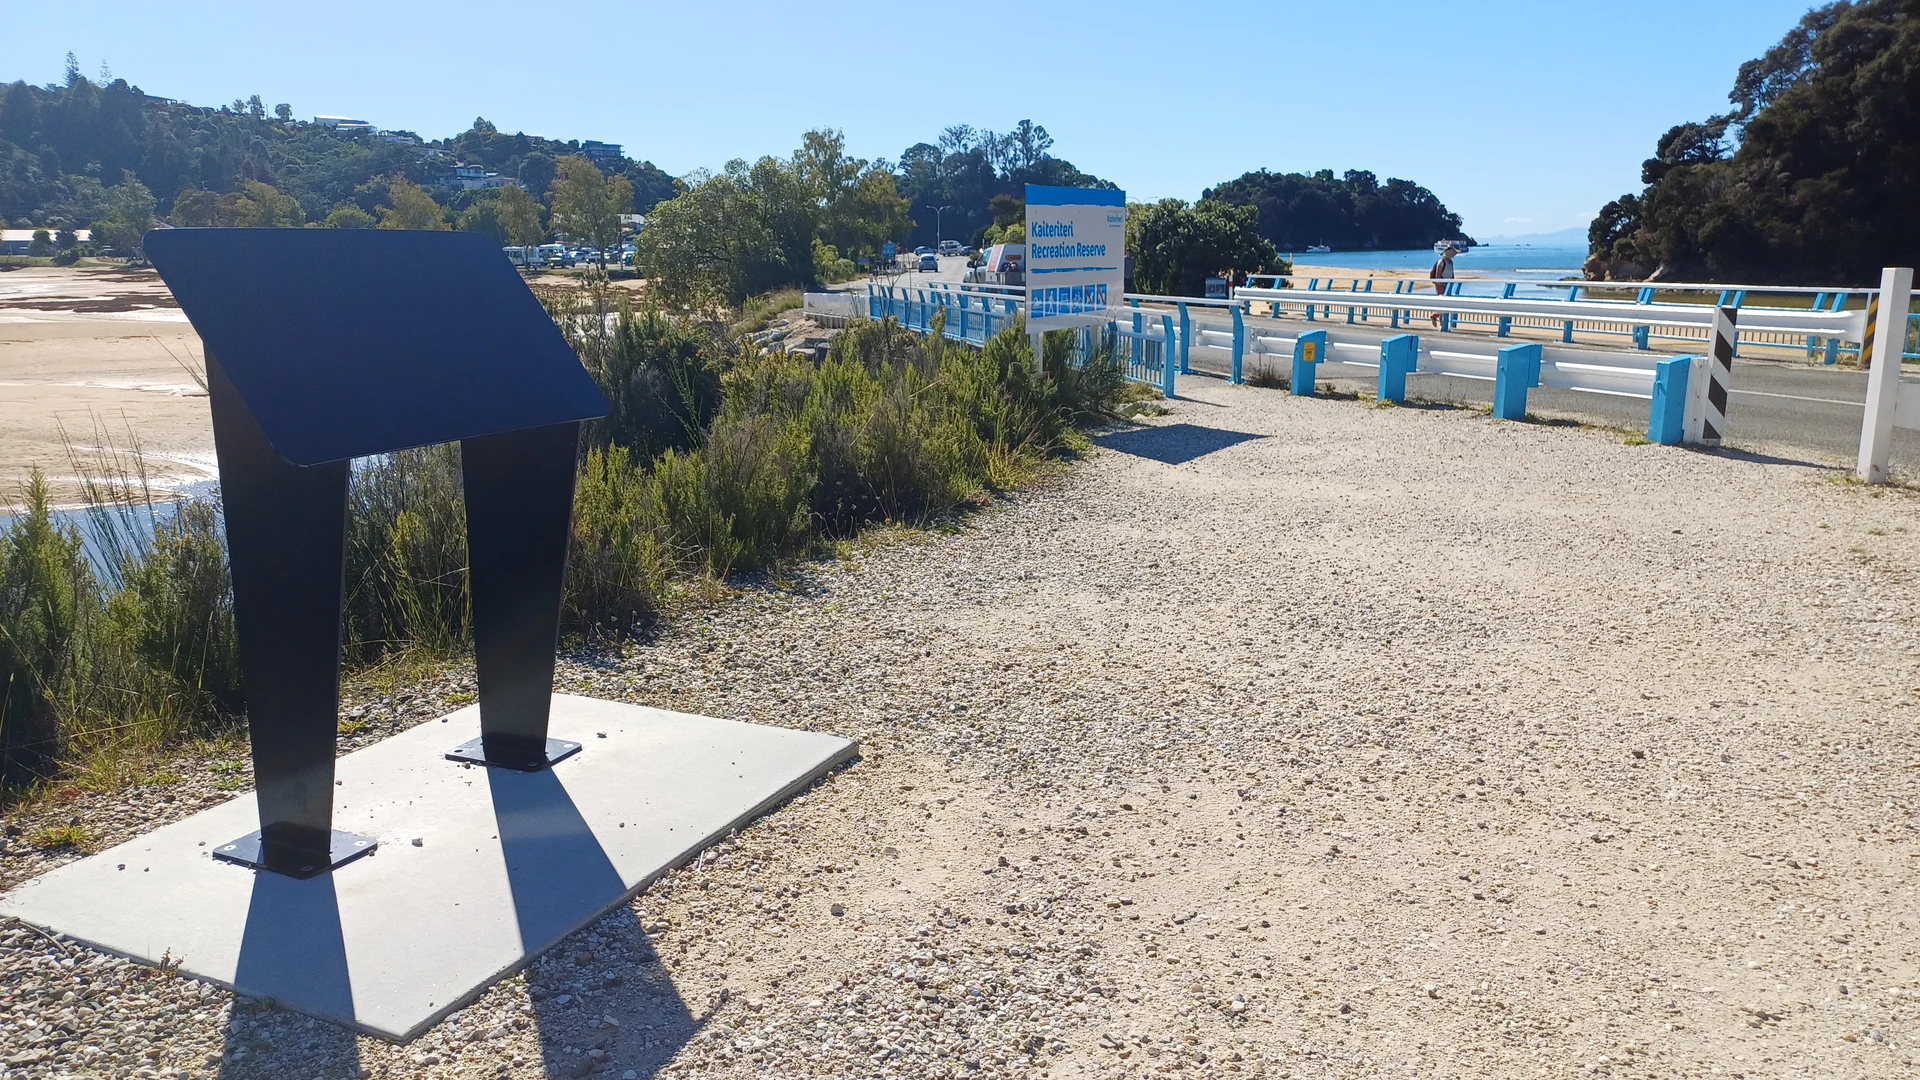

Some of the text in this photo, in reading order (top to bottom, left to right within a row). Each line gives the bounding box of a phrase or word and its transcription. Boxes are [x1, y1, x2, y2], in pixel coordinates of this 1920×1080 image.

[1031, 221, 1074, 238] Kaiteriteri
[1031, 242, 1106, 259] Recreation Reserve
